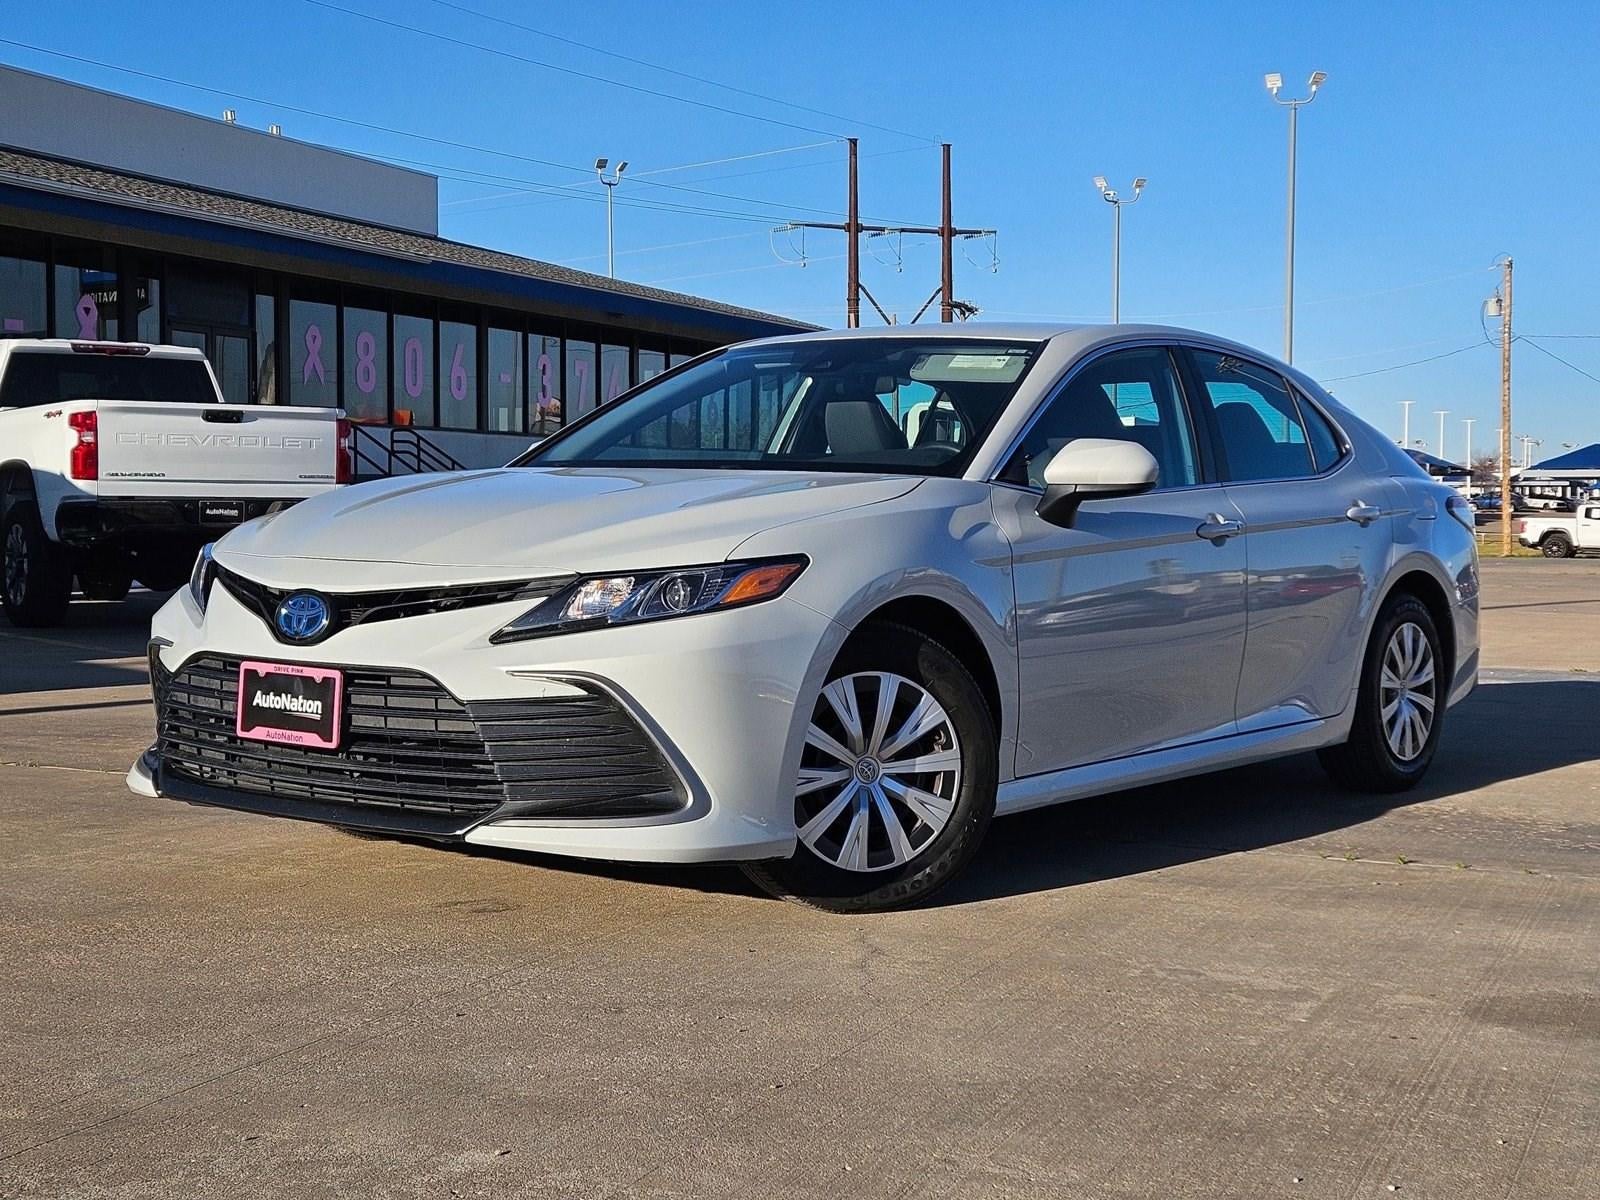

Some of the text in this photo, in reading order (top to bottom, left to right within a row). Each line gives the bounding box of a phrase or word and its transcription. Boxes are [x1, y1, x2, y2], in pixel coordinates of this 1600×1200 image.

[115, 431, 320, 448] CHEVROLET
[252, 690, 322, 714] AutoNation
[266, 730, 303, 743] AutoNation
